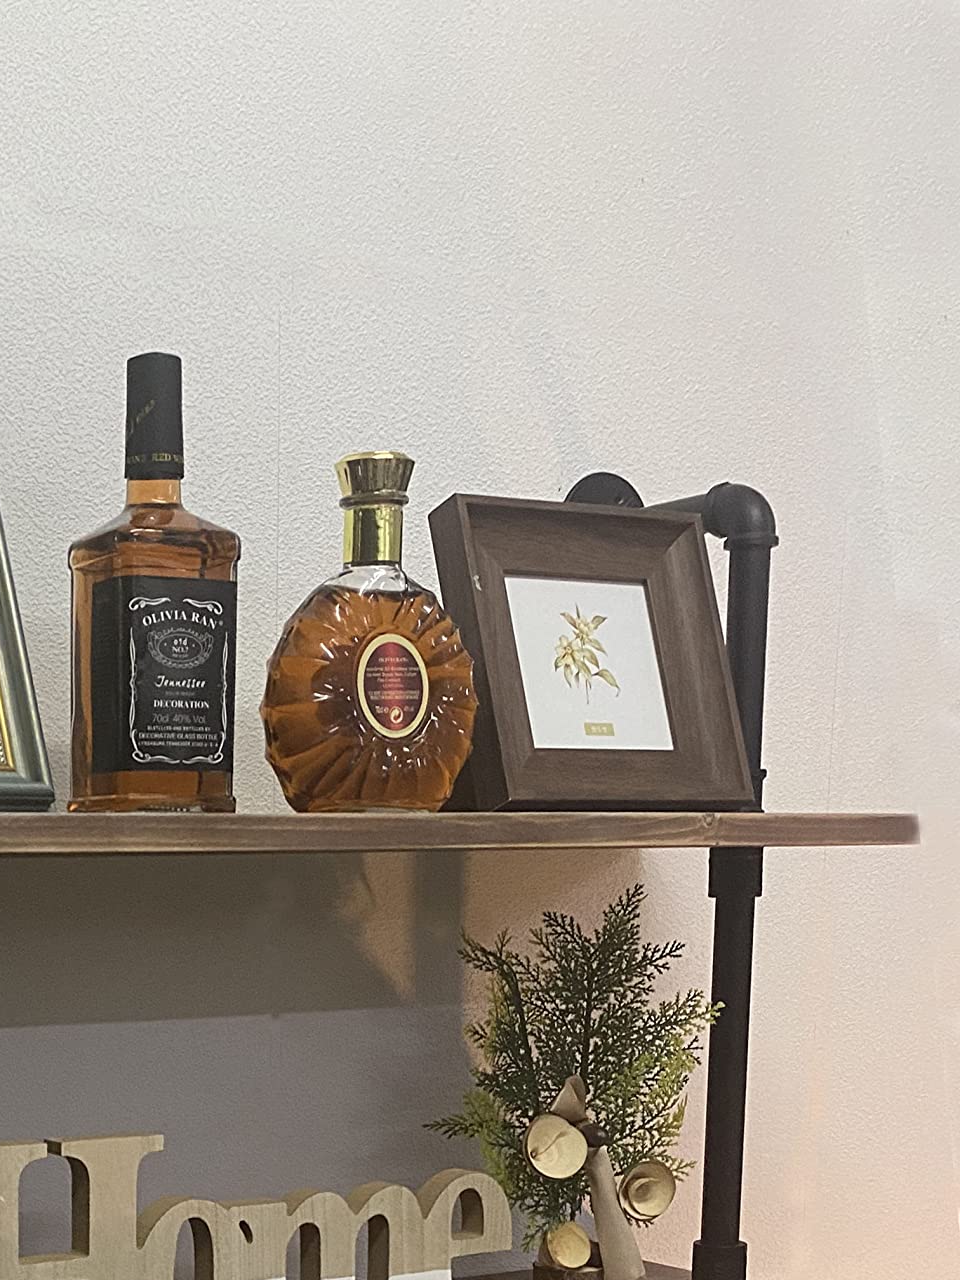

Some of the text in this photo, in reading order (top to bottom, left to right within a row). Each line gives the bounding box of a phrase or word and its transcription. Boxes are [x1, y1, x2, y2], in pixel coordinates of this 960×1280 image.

[142, 610, 218, 630] OLIVIA RAN
[153, 700, 210, 709] DECORATION
